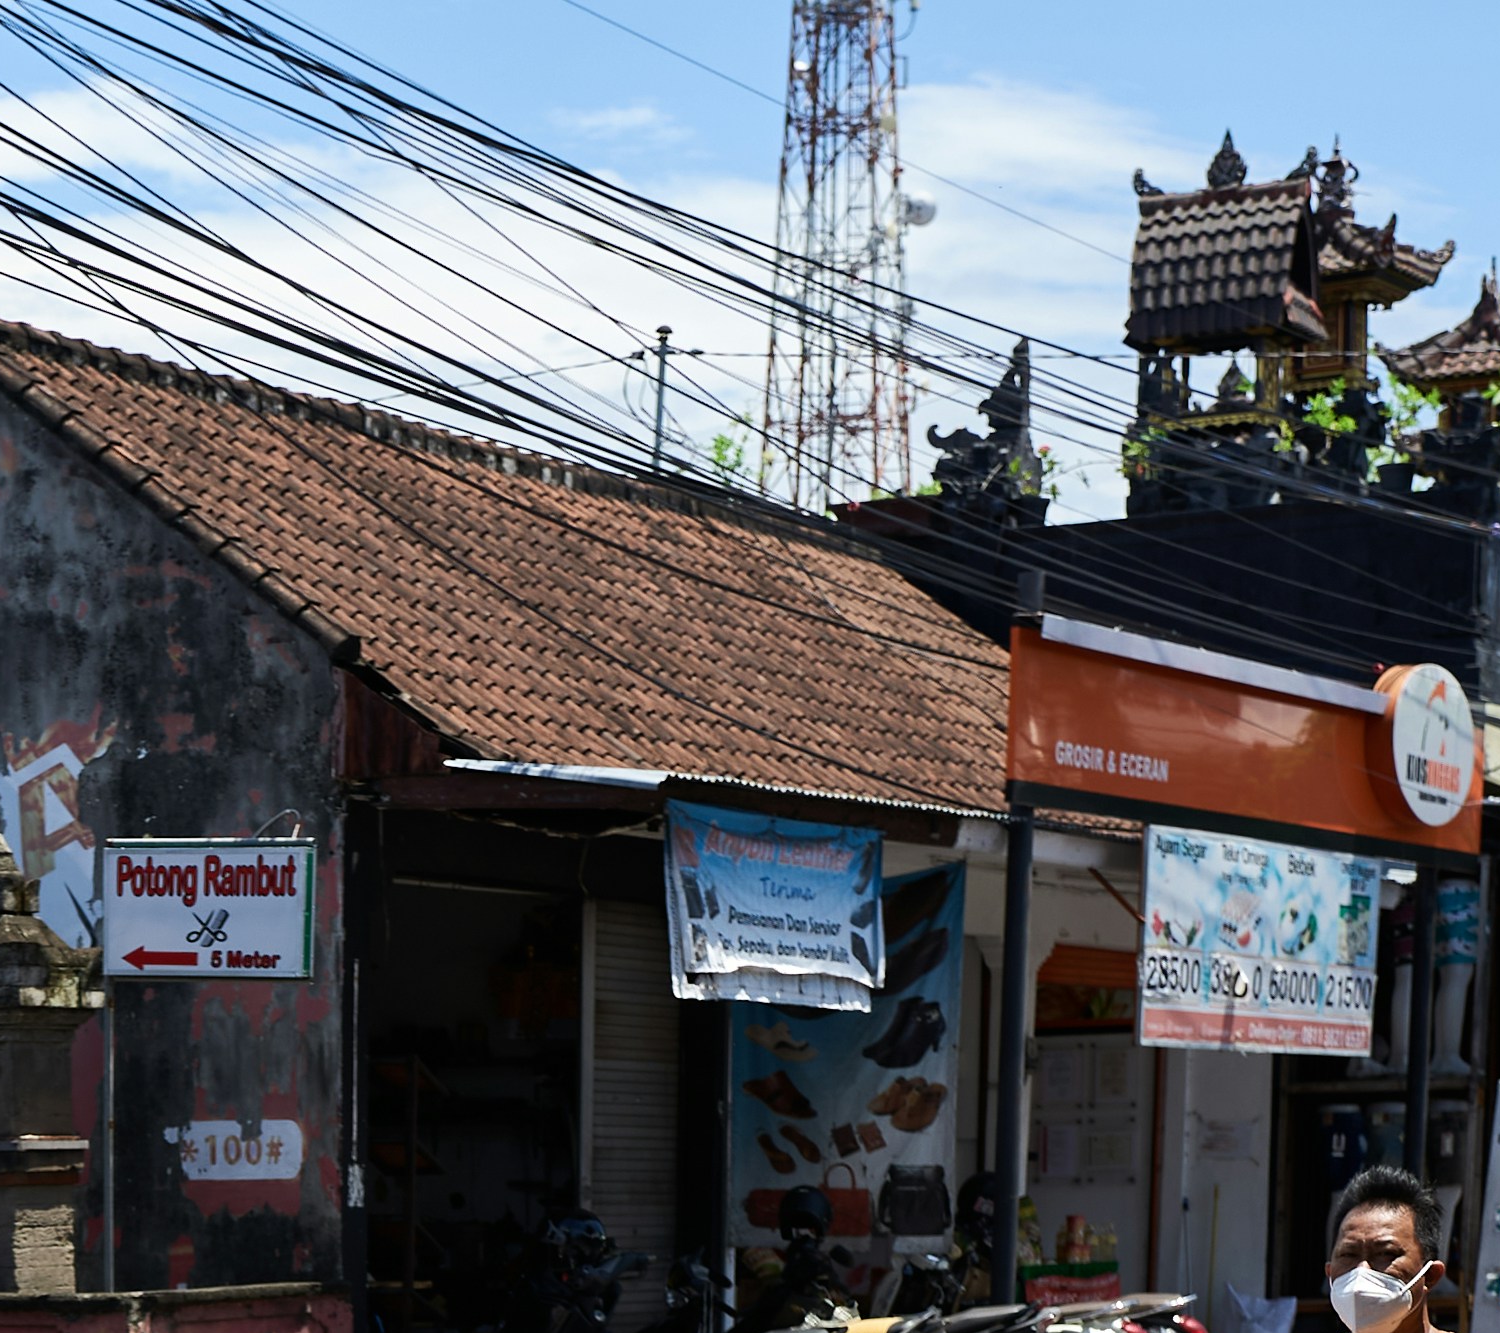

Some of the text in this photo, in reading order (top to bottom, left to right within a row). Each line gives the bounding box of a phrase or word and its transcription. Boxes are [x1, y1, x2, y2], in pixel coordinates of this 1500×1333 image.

[1055, 740, 1169, 782] GROSIR & ECERAN
[1155, 834, 1208, 864] Ayam Segar
[1288, 853, 1317, 876] Bebek
[116, 854, 297, 907] Potong Rambut
[785, 913, 807, 932] Dan
[210, 951, 281, 968] 5 Meter
[1269, 965, 1318, 1005] 60000
[1325, 973, 1372, 1011] 21500
